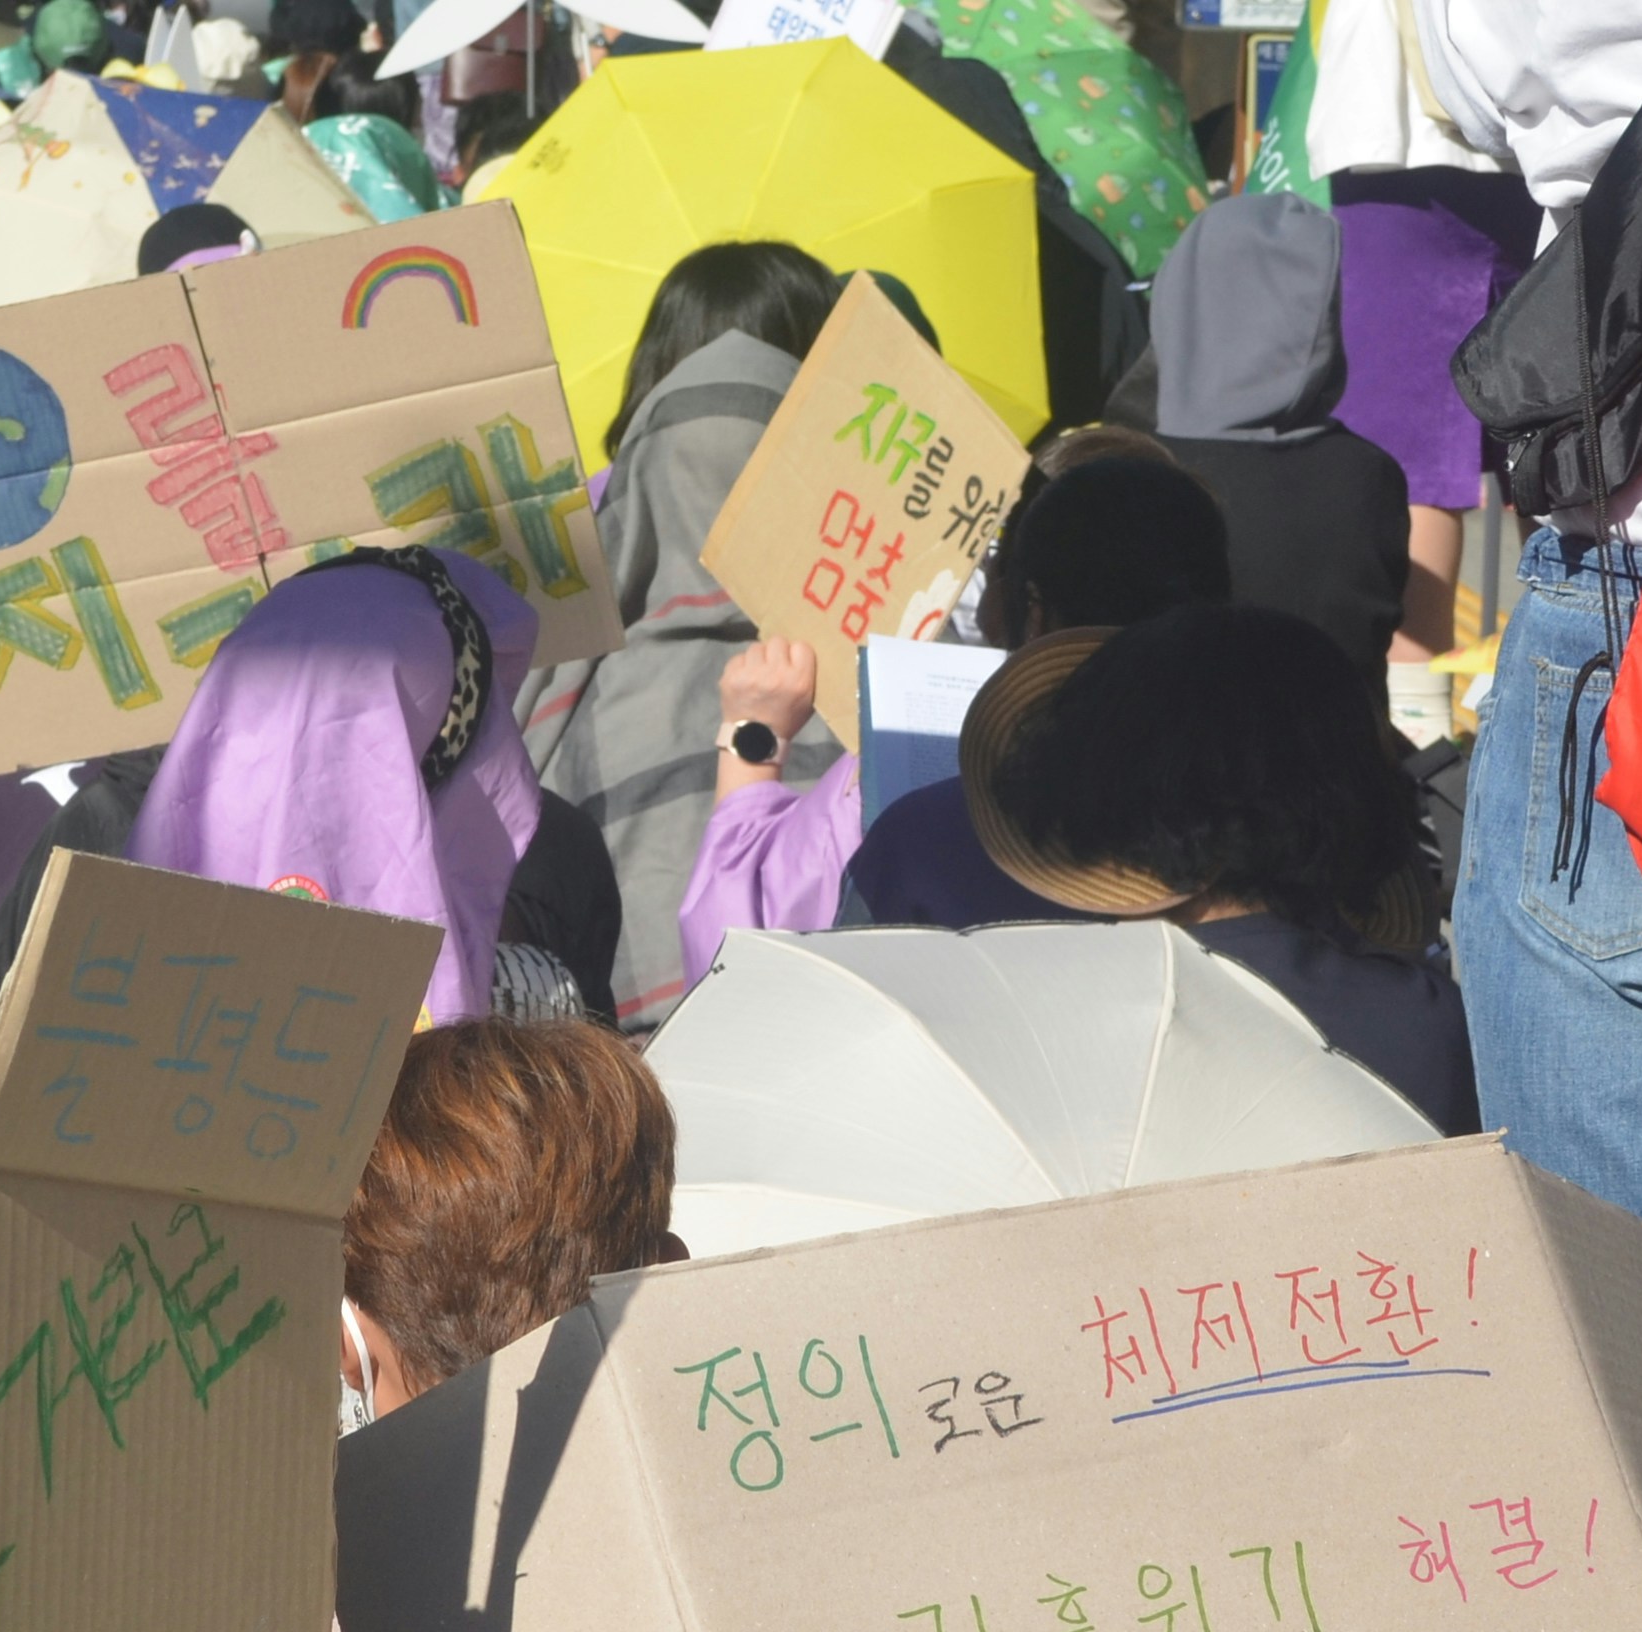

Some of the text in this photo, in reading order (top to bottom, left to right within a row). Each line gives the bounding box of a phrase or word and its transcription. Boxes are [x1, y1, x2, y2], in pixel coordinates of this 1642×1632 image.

[833, 382, 955, 521] 지구를
[804, 488, 906, 643] 멈춤
[36, 915, 389, 1174] 불평등!
[1079, 1247, 1480, 1399] 체제전환!
[1396, 1496, 1599, 1601] 해결!
